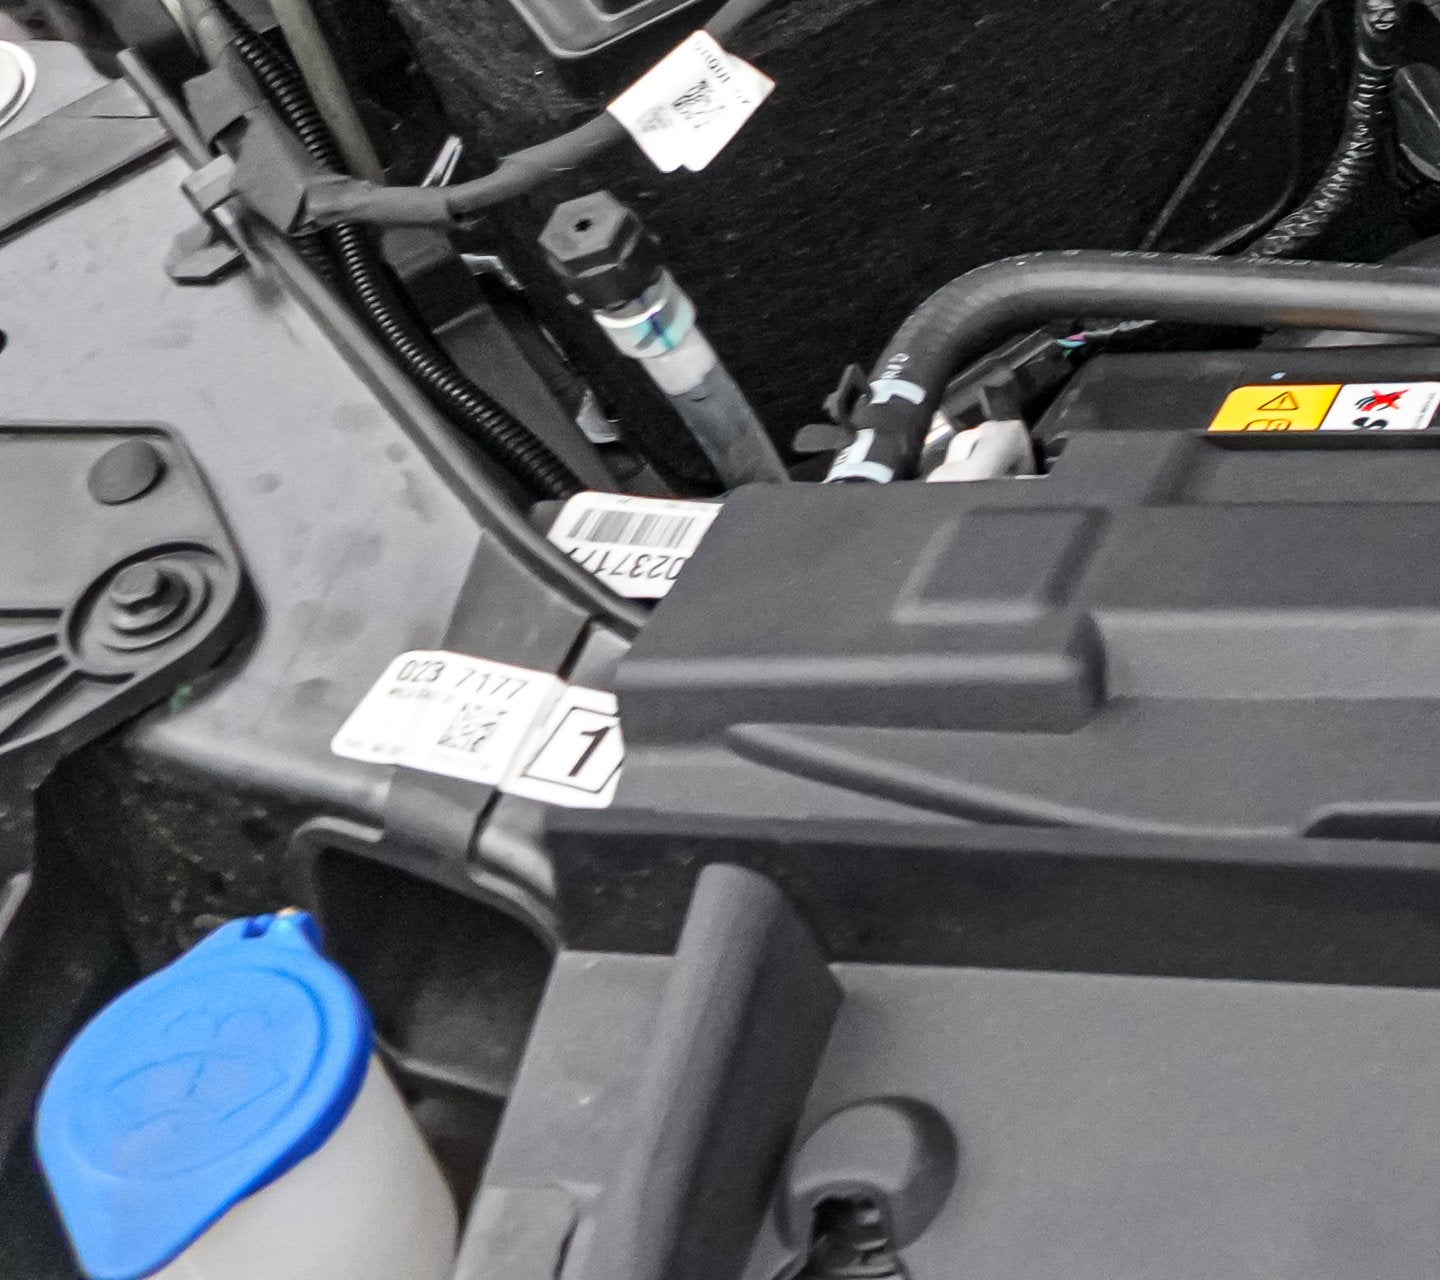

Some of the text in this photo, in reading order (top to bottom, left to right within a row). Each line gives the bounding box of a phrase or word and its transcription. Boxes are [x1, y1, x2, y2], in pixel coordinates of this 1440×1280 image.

[396, 658, 447, 683] 023
[454, 667, 529, 701] 7177
[567, 725, 614, 778] 1
